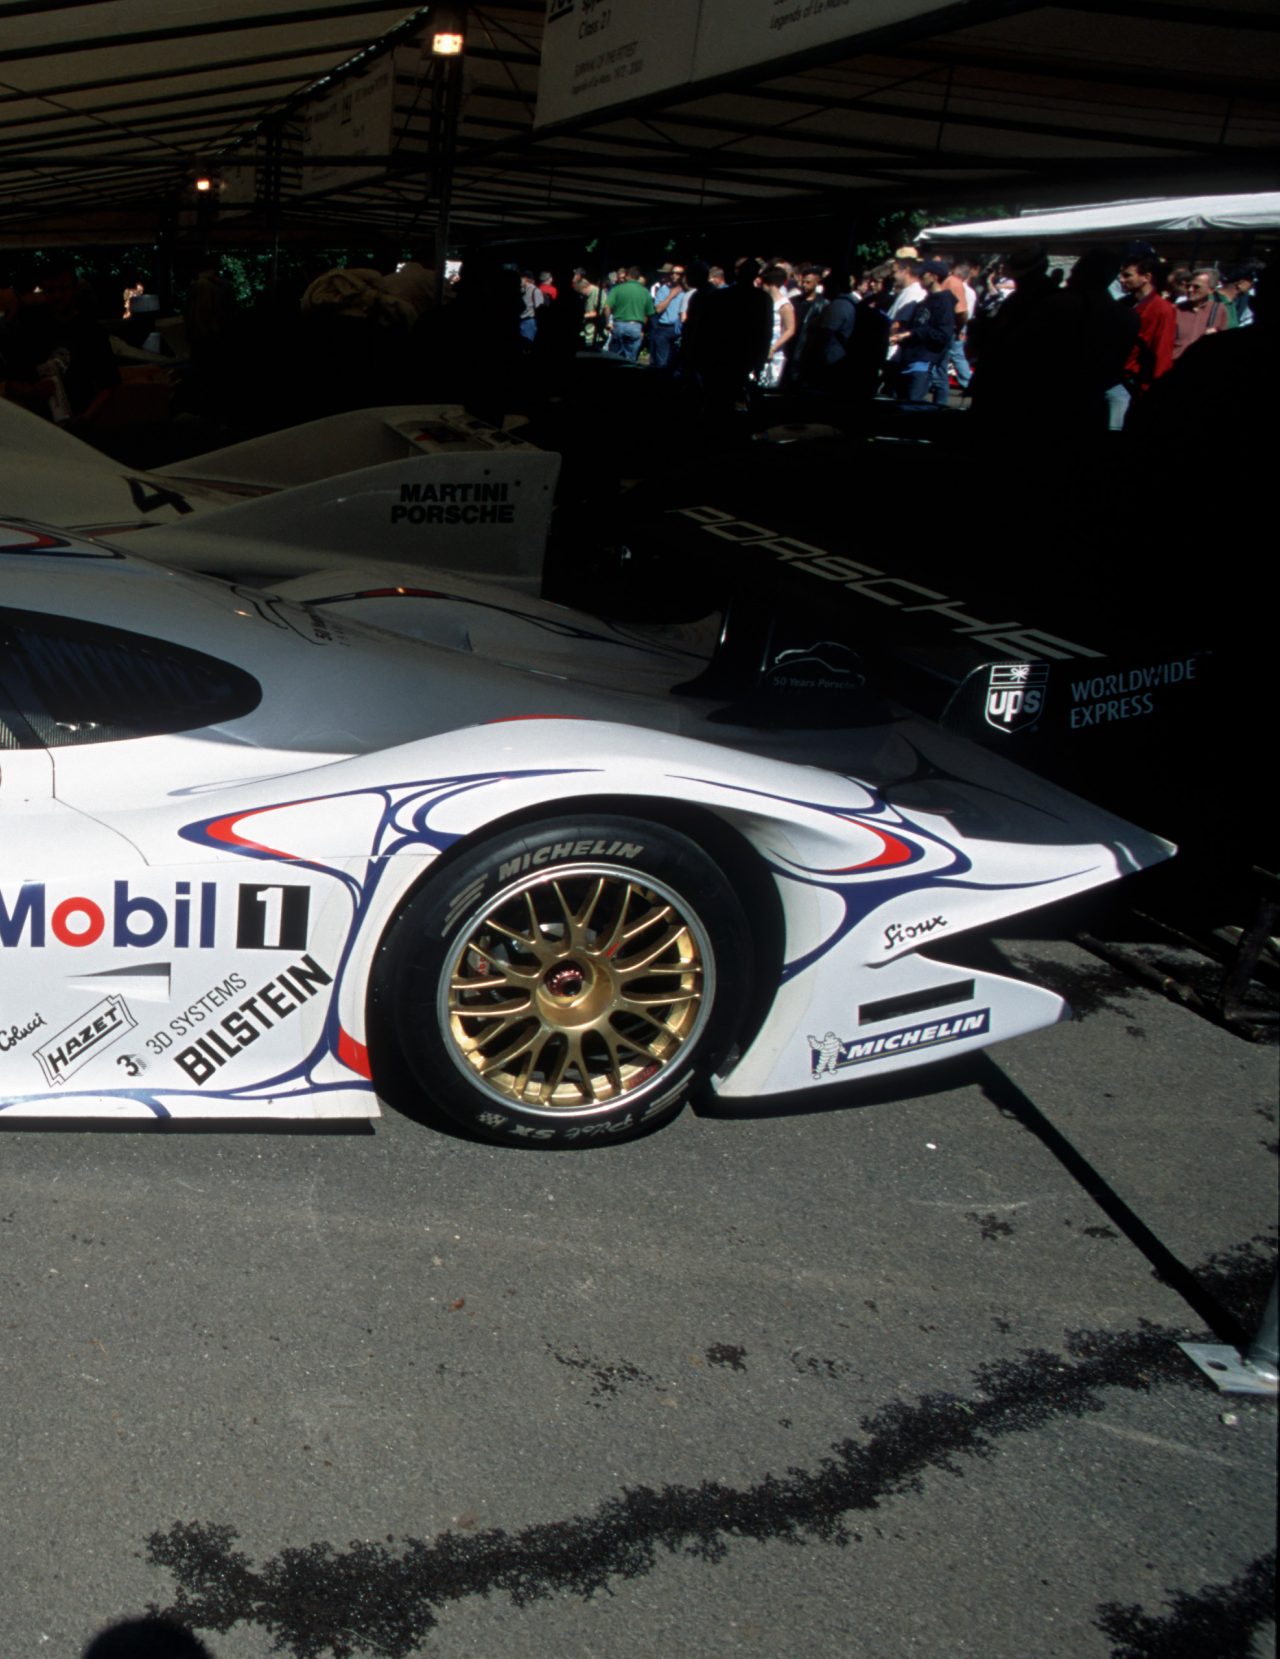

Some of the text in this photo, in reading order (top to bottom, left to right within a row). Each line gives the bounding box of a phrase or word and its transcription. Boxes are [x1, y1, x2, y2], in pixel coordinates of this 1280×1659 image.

[400, 483, 508, 502] MARTINI
[391, 504, 515, 524] PORSCHE
[664, 504, 1109, 661] PORSCHE
[789, 677, 816, 688] Years
[1070, 658, 1197, 703] WORLDWIDE
[1070, 693, 1154, 729] EXPRESS
[498, 840, 645, 882] MICHELIN
[884, 915, 948, 949] Sioux
[145, 1031, 174, 1055] 3D
[169, 972, 247, 1036] SYSTEMS
[173, 953, 333, 1086] BILSTEIN
[47, 1006, 118, 1074] HAZET
[846, 1014, 985, 1060] MICHELIN
[508, 1113, 634, 1140] Pilot SX
